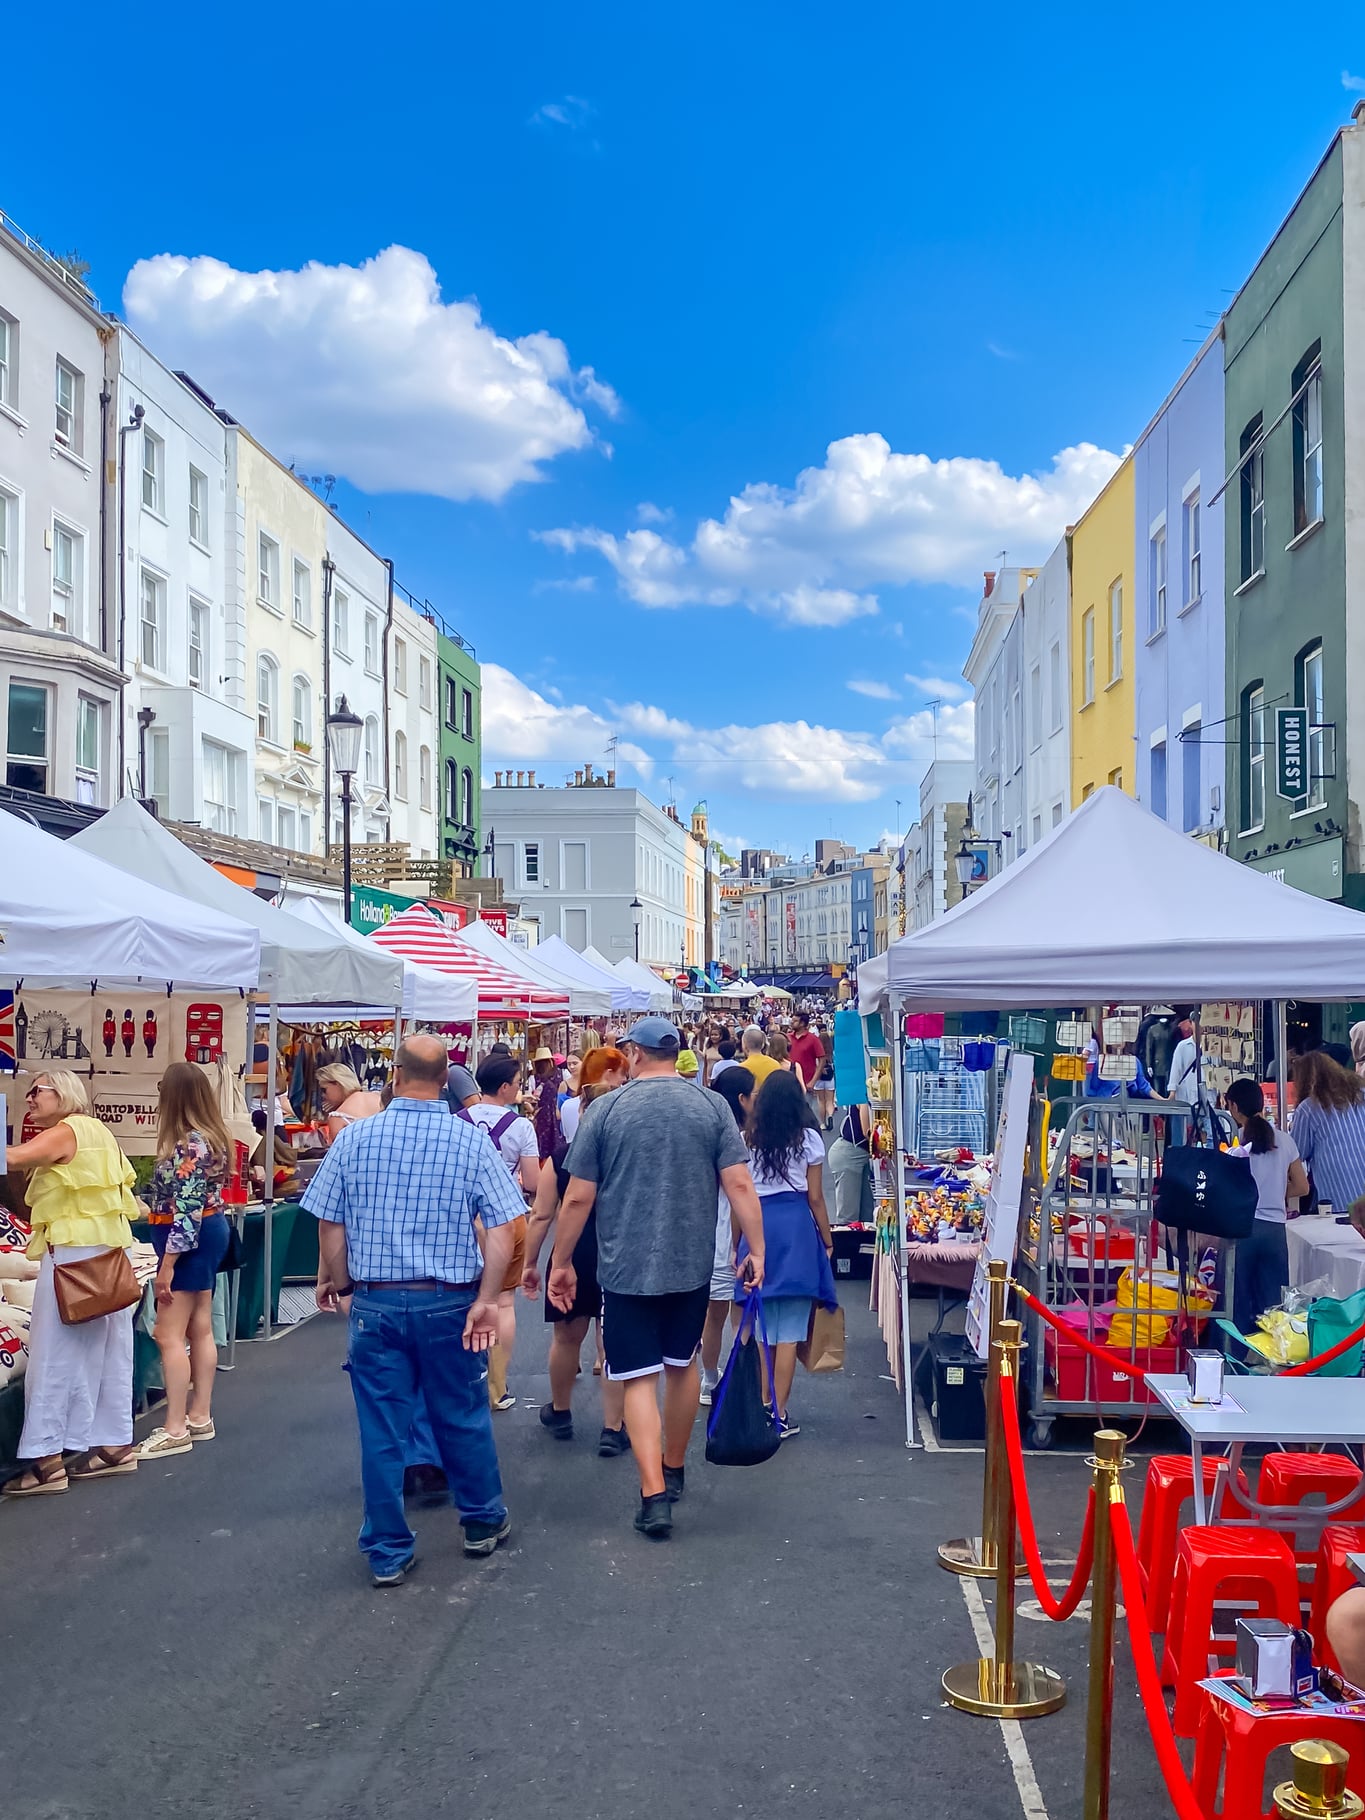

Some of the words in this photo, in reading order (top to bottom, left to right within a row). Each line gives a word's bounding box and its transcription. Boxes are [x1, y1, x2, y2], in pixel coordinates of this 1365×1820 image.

[1285, 717, 1300, 789] HONEST
[360, 899, 385, 924] Holland
[94, 1104, 158, 1114] PORTOBELL
